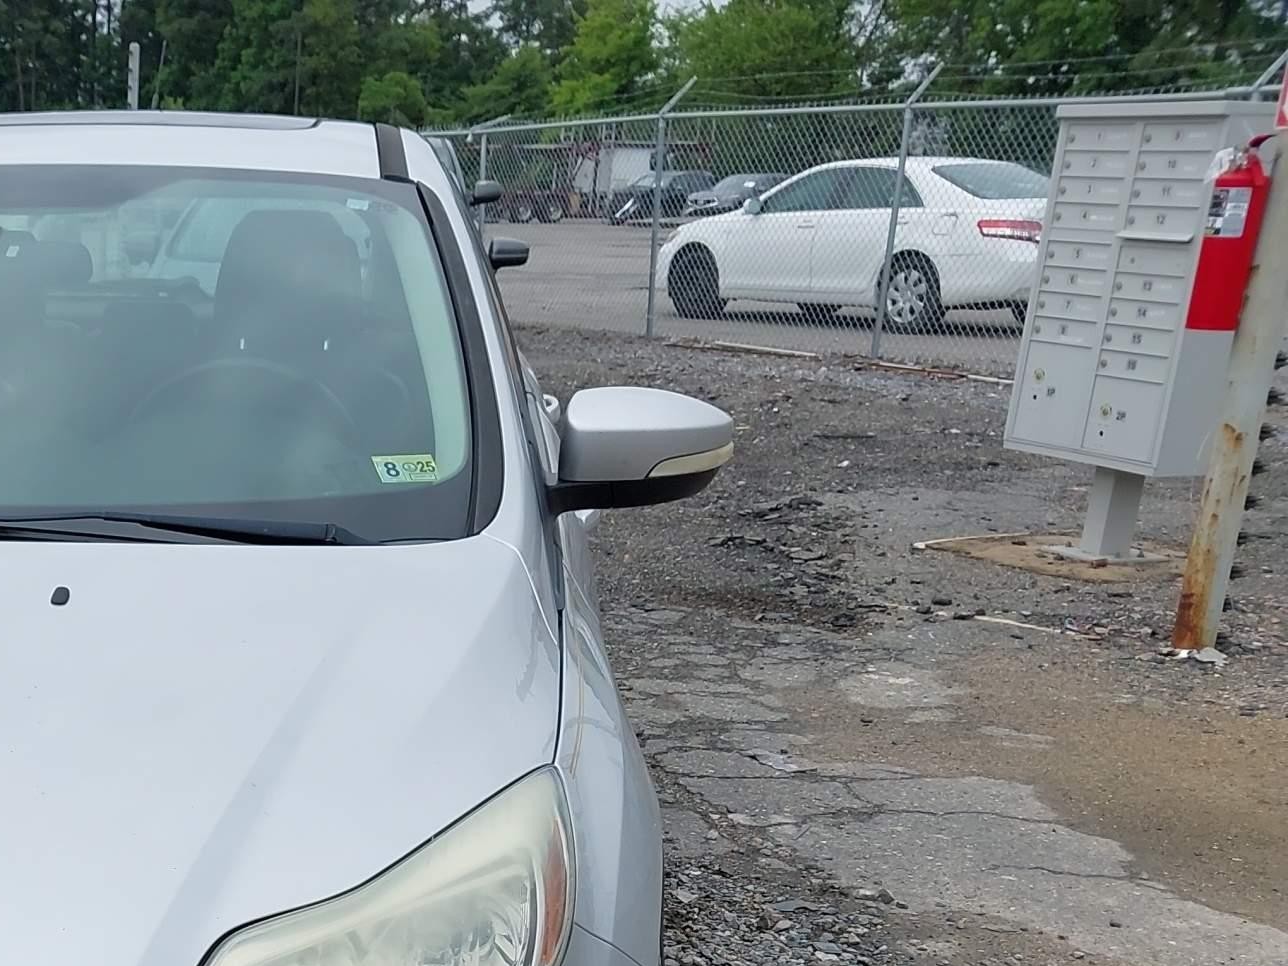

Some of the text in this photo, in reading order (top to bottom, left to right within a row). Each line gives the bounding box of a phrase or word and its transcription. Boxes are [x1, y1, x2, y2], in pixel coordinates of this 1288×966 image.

[1156, 214, 1166, 224] 12
[1132, 334, 1142, 344] 15
[384, 462, 400, 477] 8
[416, 461, 436, 472] 25
